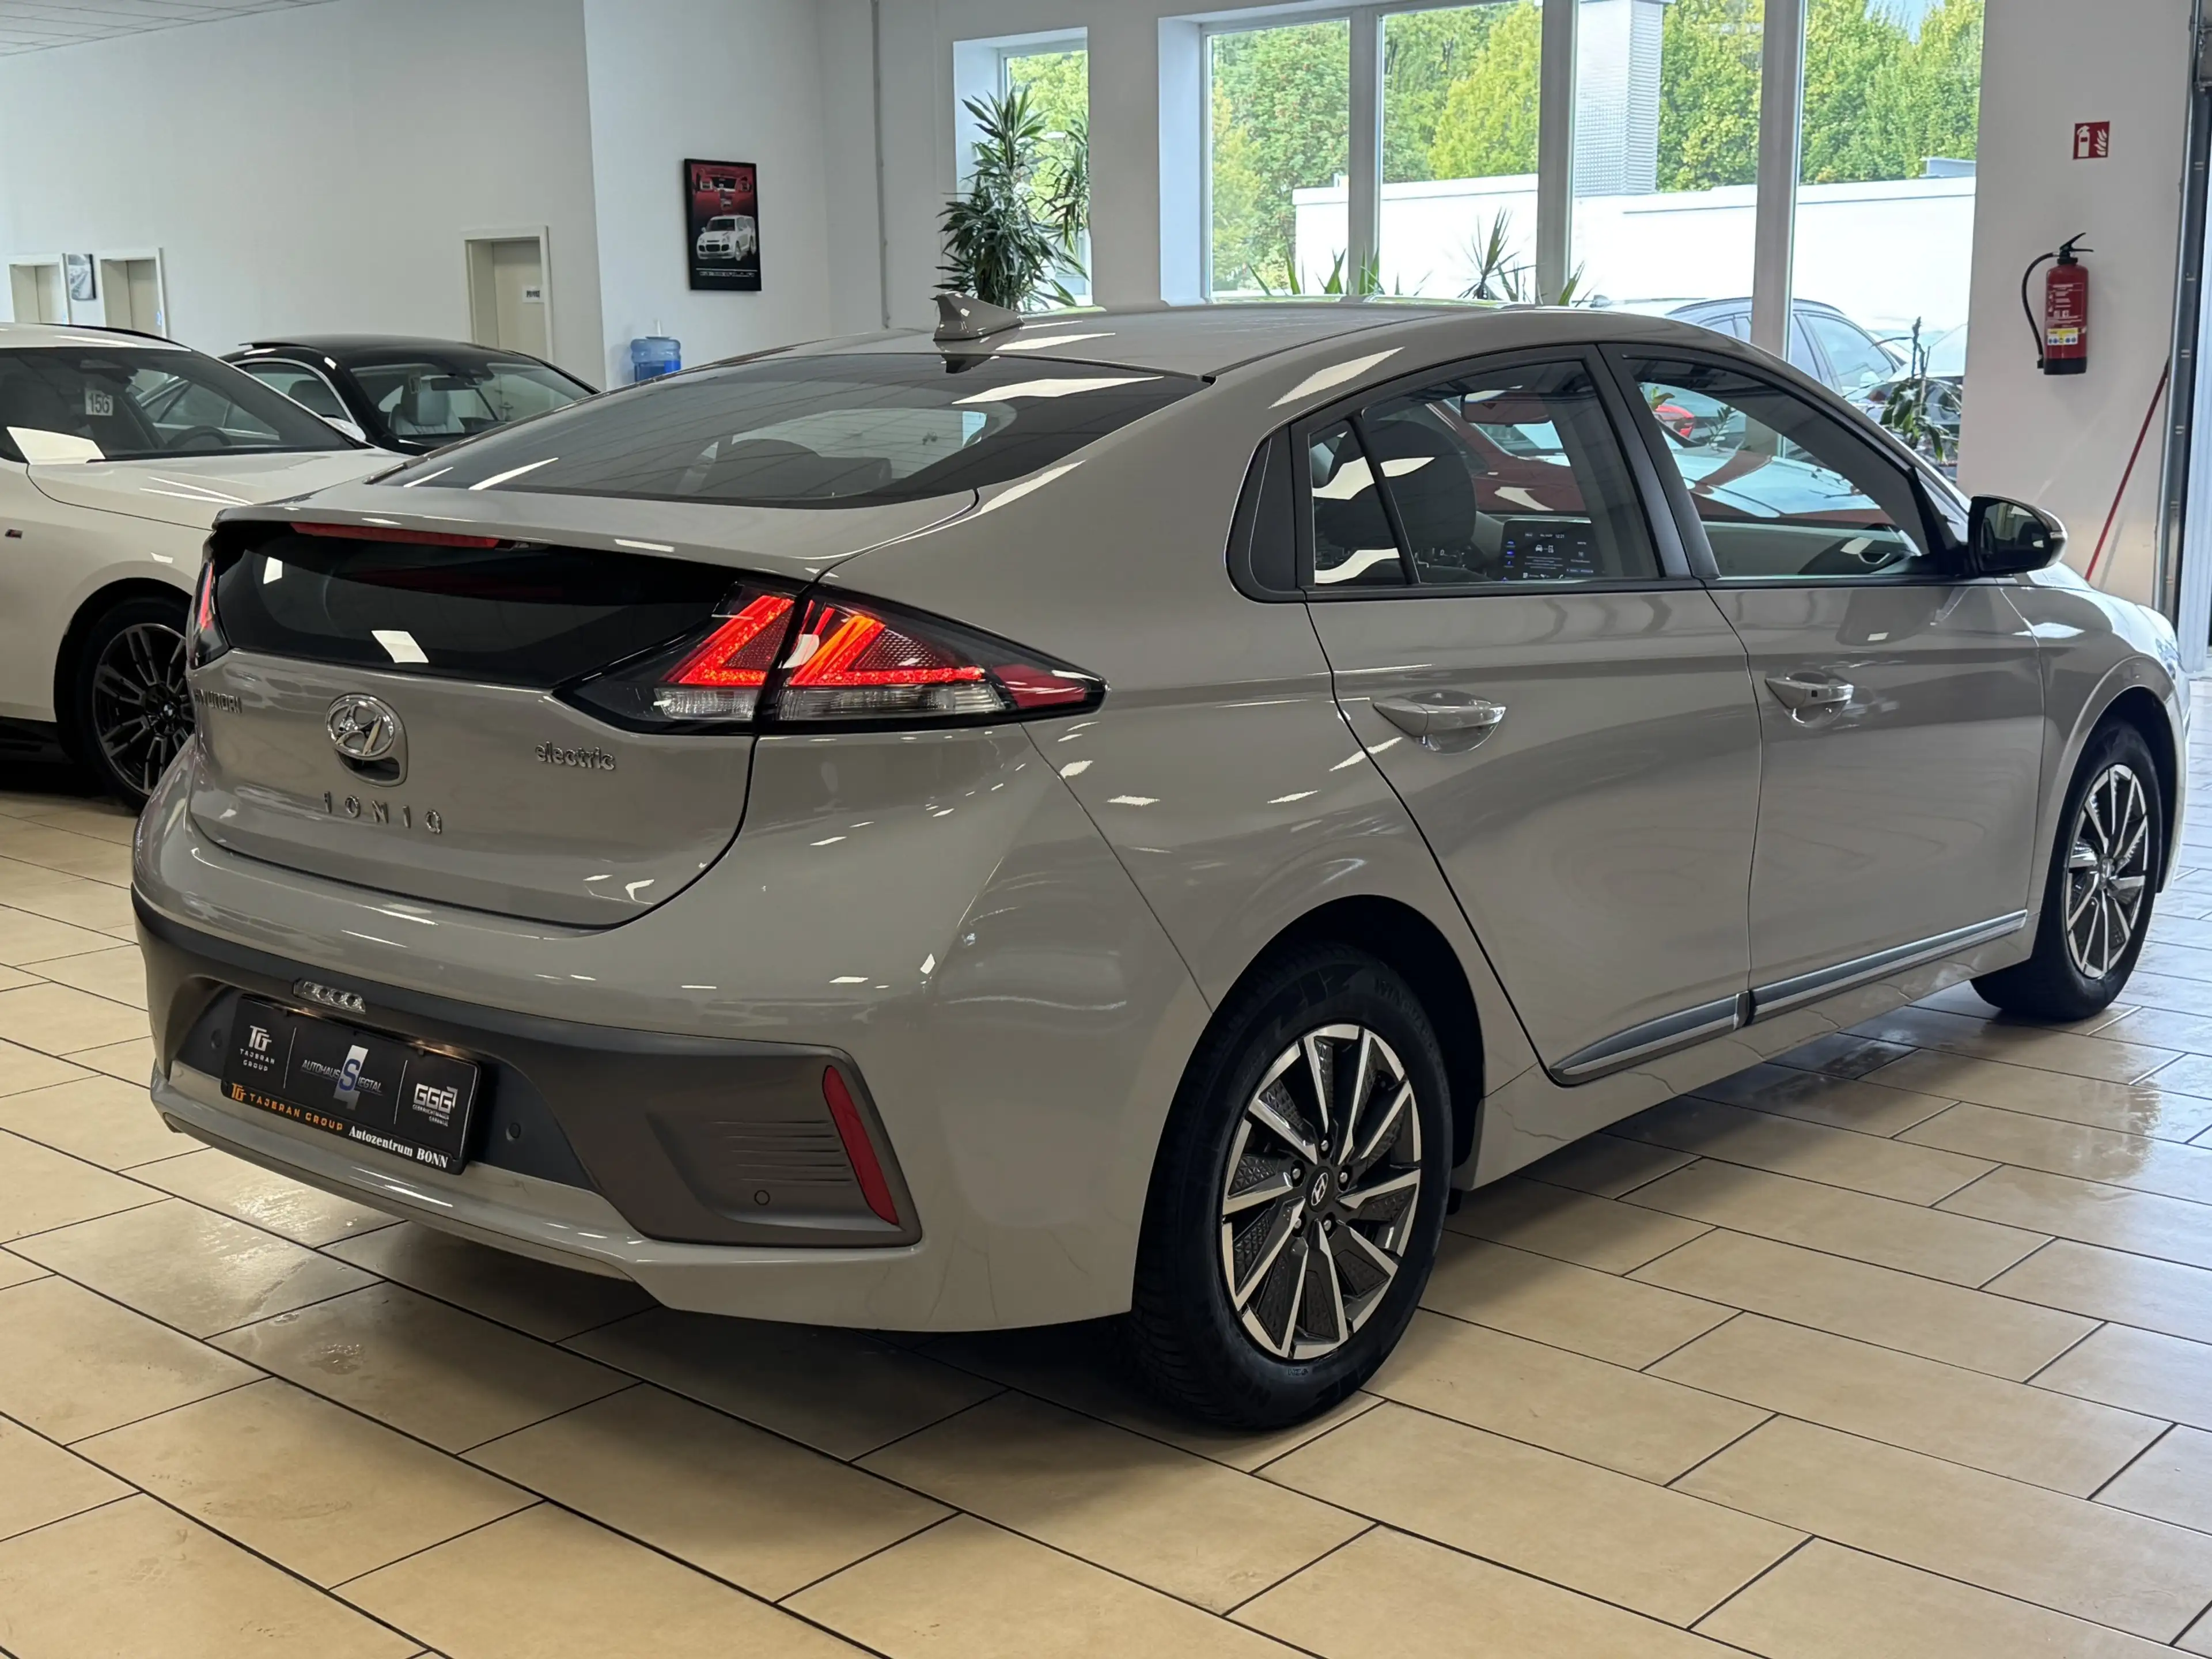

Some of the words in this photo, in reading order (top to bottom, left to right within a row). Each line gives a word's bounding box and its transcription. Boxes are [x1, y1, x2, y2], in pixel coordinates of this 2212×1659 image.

[89, 393, 110, 414] 156
[192, 688, 243, 714] HYUNDAI
[535, 741, 617, 771] electric
[323, 791, 444, 835] IONIQ
[239, 1048, 275, 1065] TAJERAN
[243, 1059, 268, 1071] GROUP
[301, 1059, 341, 1080] AUTOHAUS
[414, 1083, 453, 1114] GGG
[250, 1092, 301, 1118] TAJERAN
[305, 1112, 343, 1131] GROUP
[349, 1125, 413, 1157] Autozentrum
[416, 1147, 448, 1169] BONN
